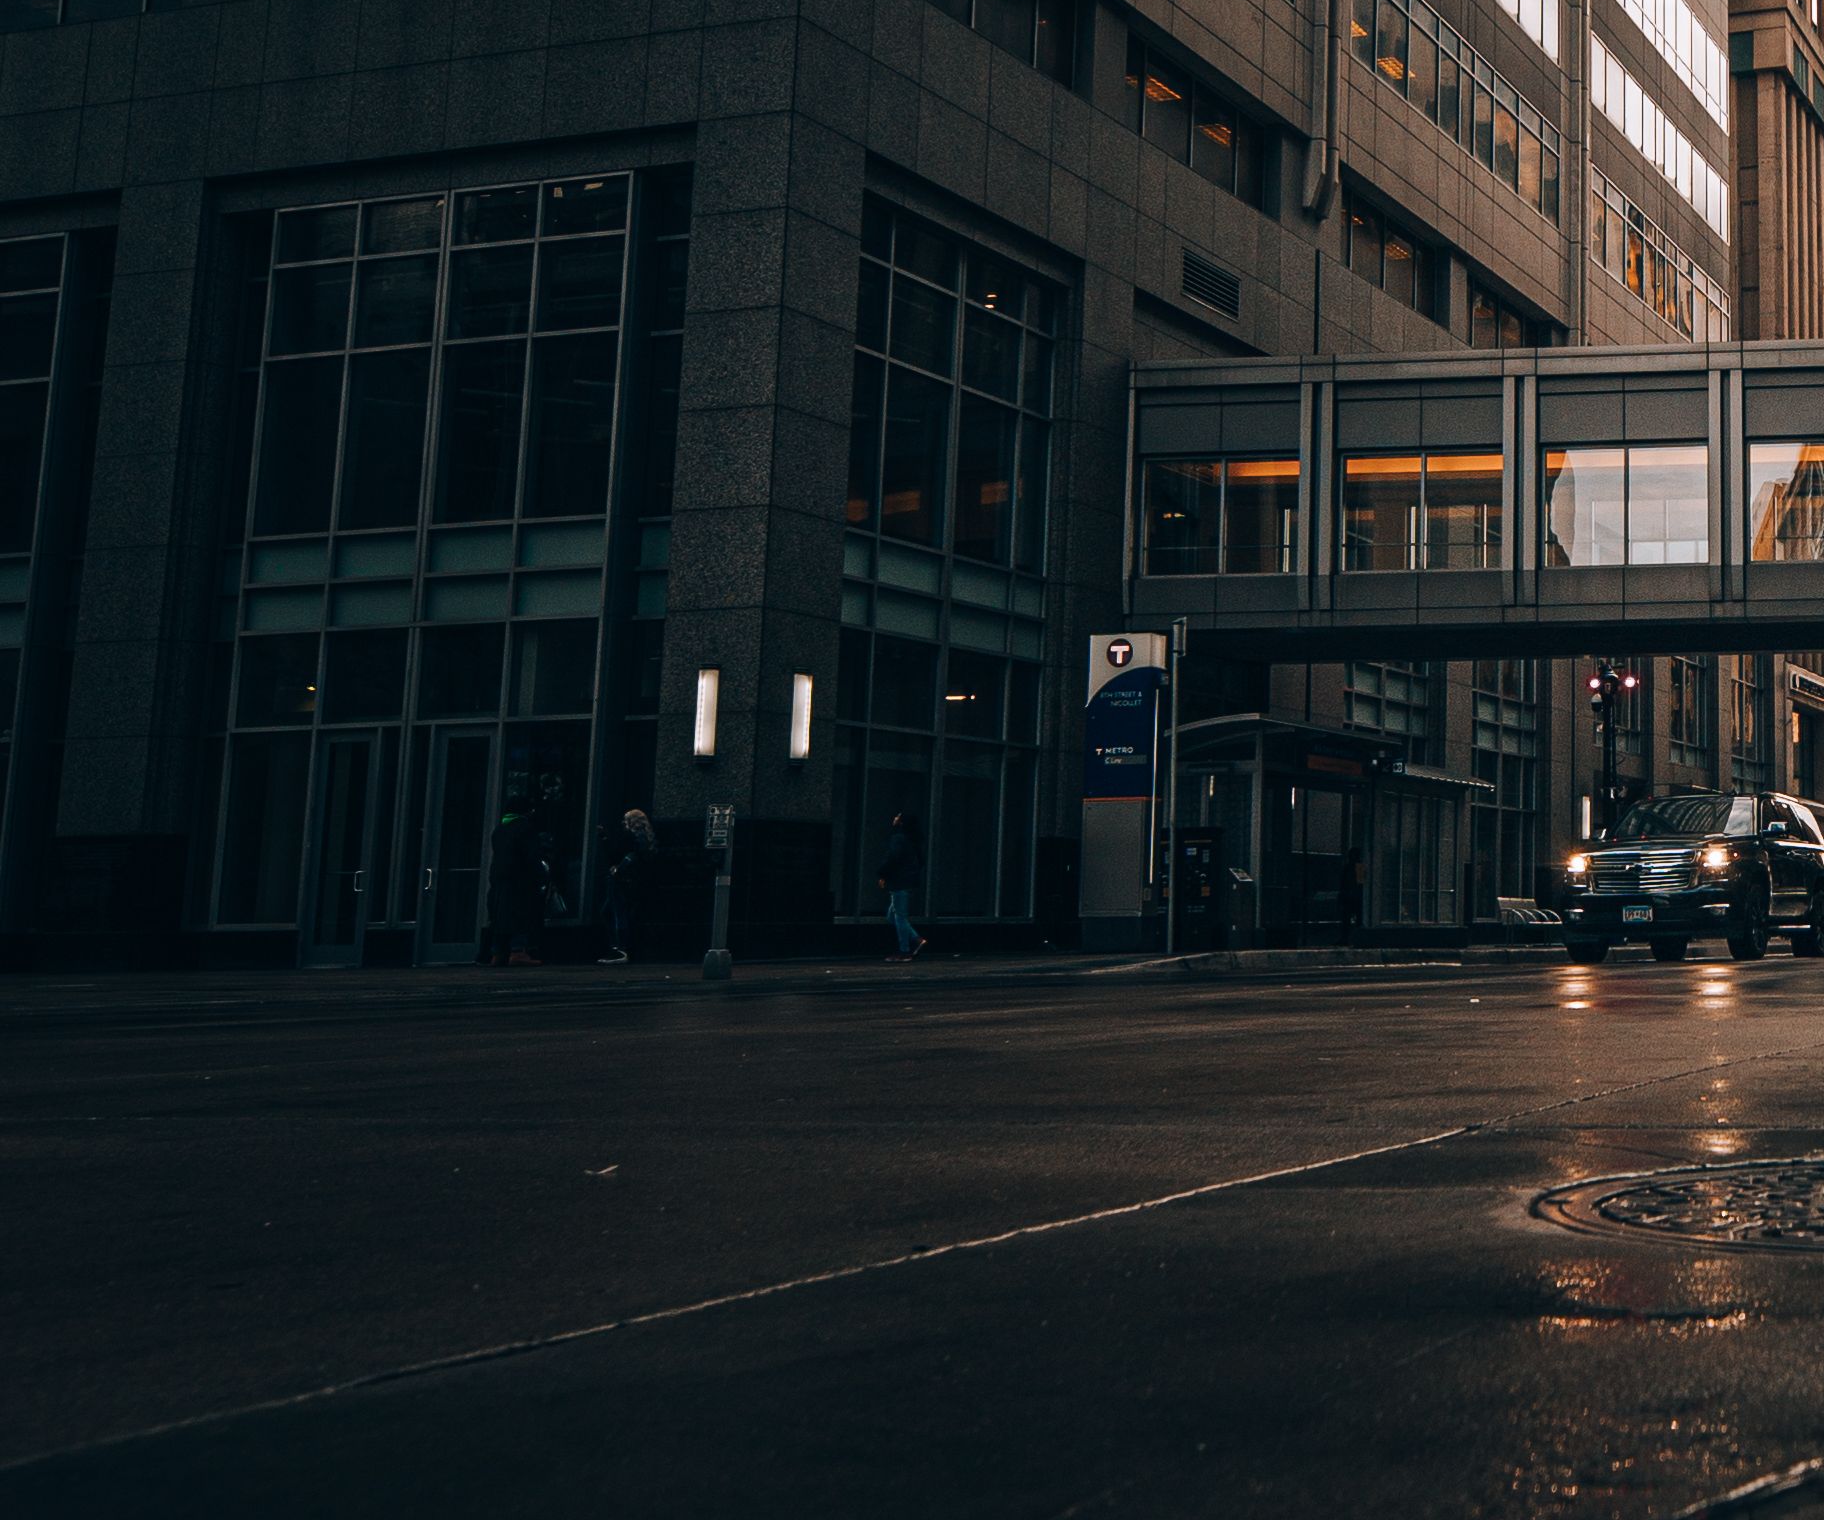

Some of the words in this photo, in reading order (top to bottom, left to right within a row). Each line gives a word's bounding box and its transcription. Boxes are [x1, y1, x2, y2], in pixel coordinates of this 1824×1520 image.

[1110, 645, 1130, 664] T
[1114, 690, 1136, 698] STREET
[1110, 699, 1142, 707] NICOLLET
[1105, 746, 1133, 754] METRO
